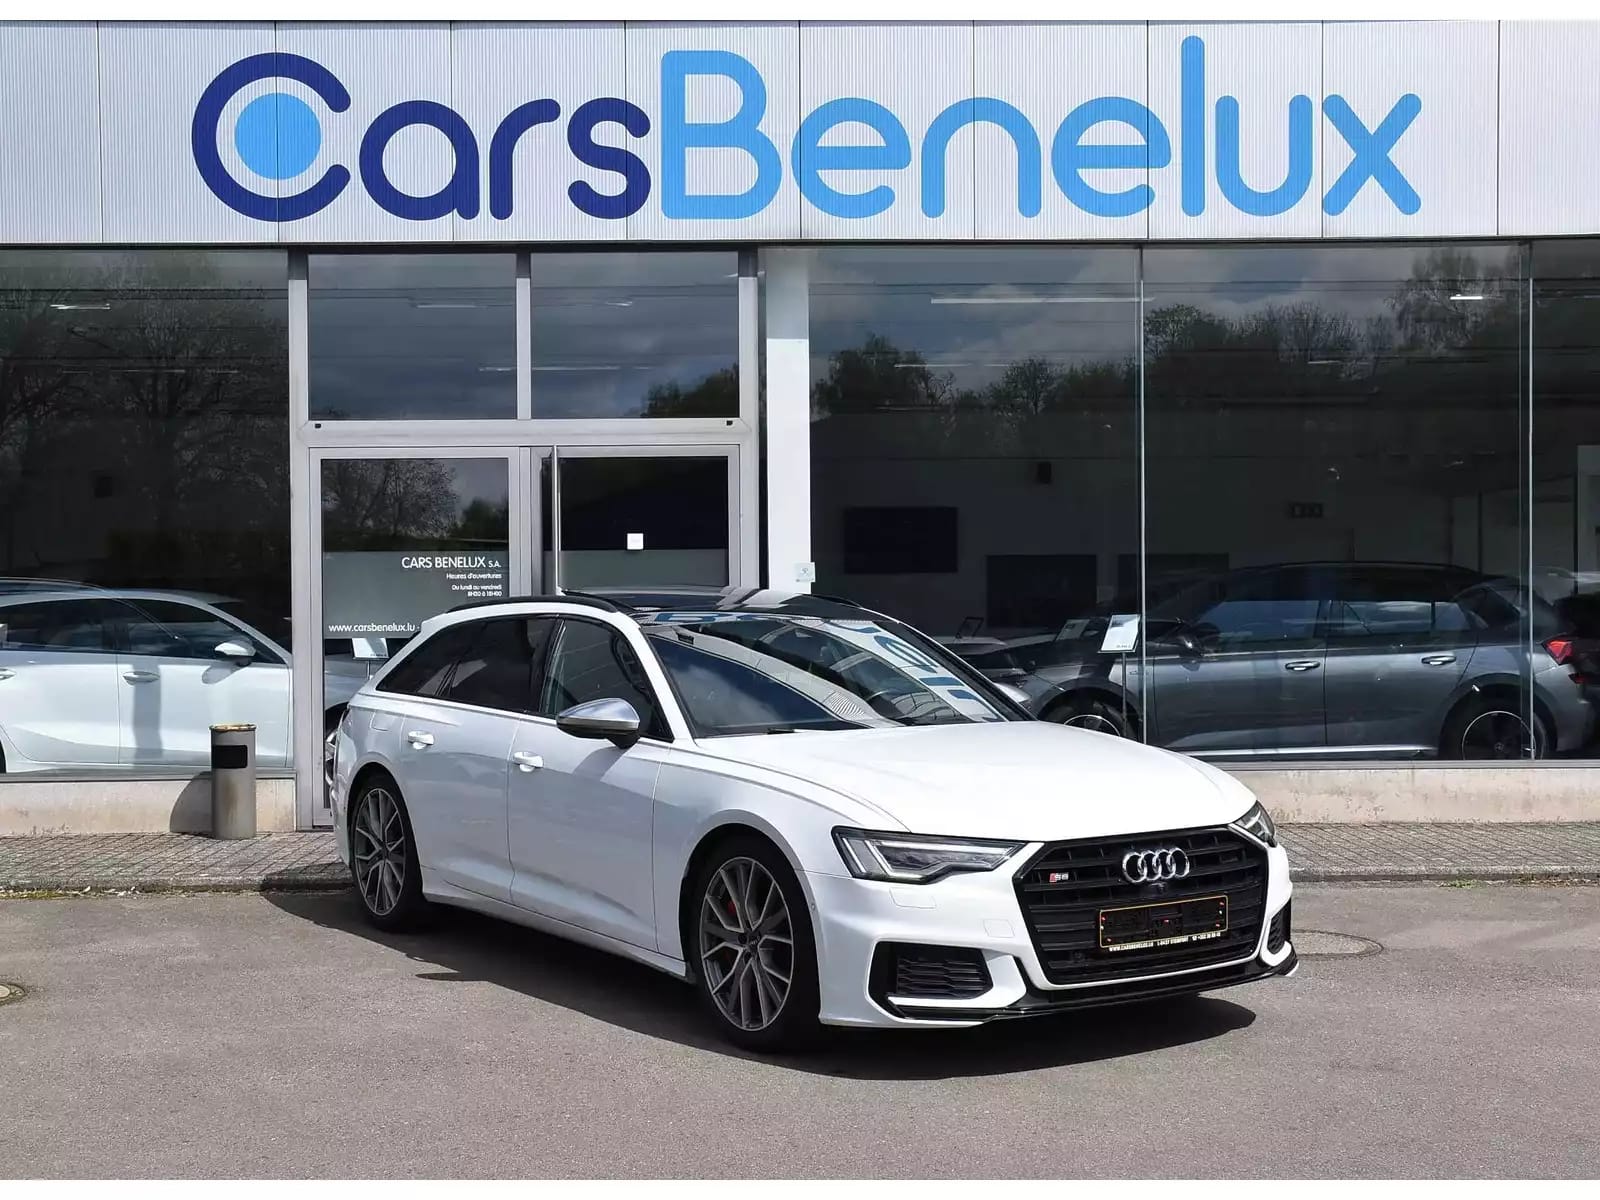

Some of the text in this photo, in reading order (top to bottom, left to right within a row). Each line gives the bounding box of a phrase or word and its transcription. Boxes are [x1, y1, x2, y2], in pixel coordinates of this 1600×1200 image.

[401, 556, 502, 569] CARS BENELUX S.A.
[328, 622, 416, 633] www.carsbenelux.lu
